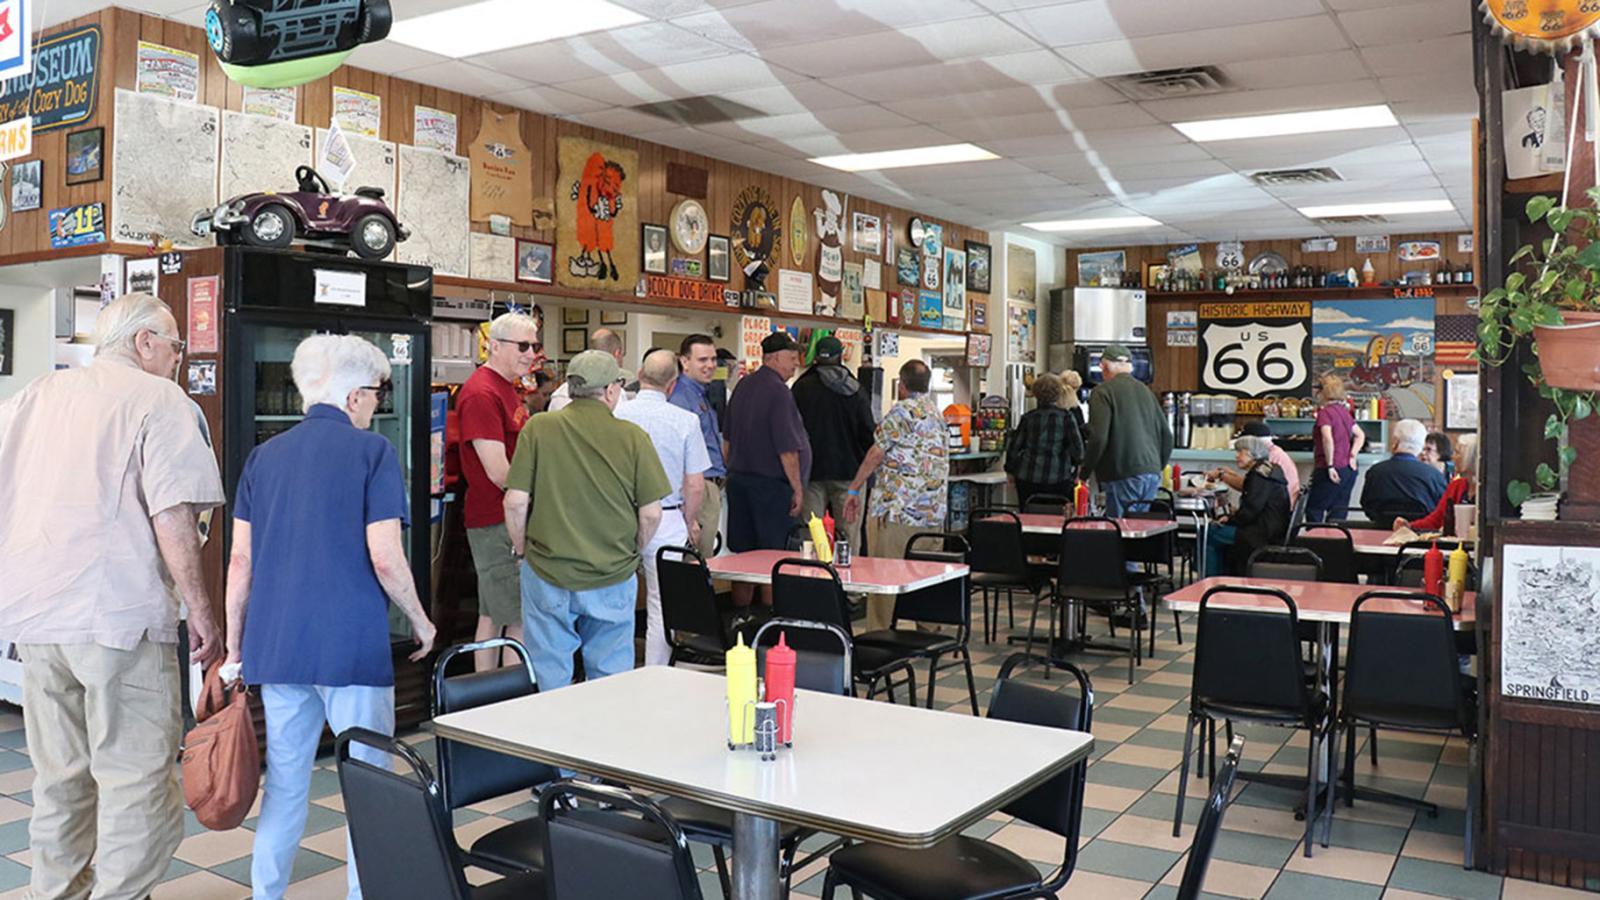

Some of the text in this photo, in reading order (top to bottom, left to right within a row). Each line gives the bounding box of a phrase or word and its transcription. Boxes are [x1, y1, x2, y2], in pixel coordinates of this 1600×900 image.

[1221, 256, 1239, 267] 66
[652, 277, 675, 297] COZY
[679, 280, 697, 300] DOG
[1202, 305, 1306, 316] HISTORIC HIGHWAY
[743, 331, 768, 344] ORDE
[1213, 342, 1294, 385] 66
[1506, 683, 1589, 701] SPRINGFIELD
